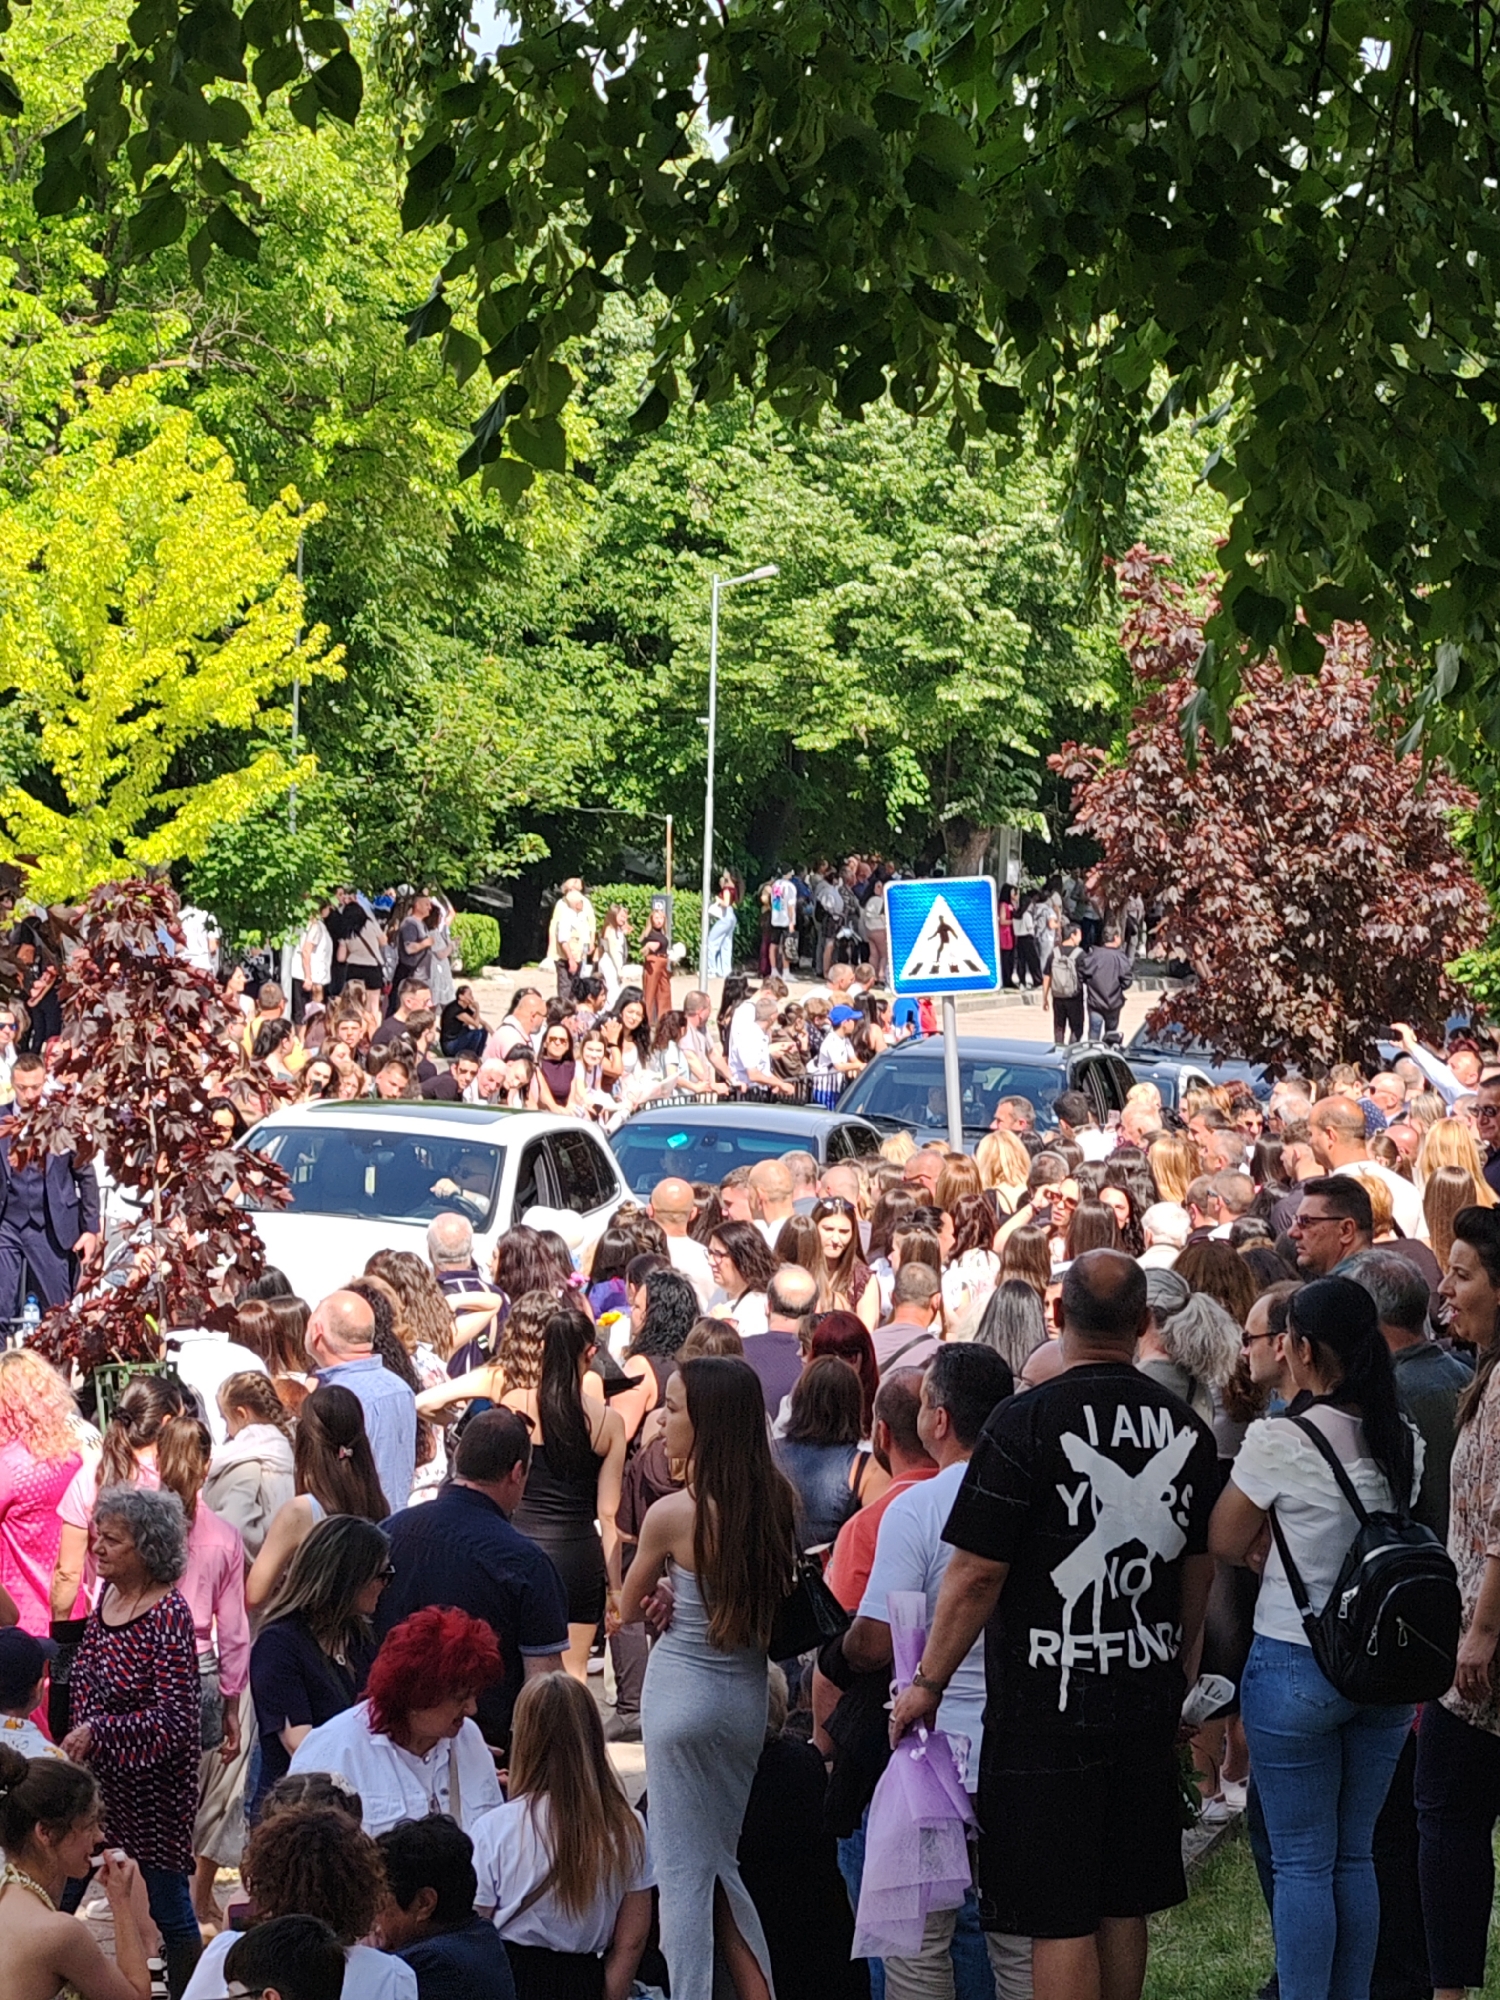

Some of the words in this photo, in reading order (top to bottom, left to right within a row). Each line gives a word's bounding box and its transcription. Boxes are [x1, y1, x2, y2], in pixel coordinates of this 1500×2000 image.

[1082, 1404, 1099, 1446] I
[1110, 1404, 1175, 1449] AM
[1055, 1481, 1193, 1527] YRS
